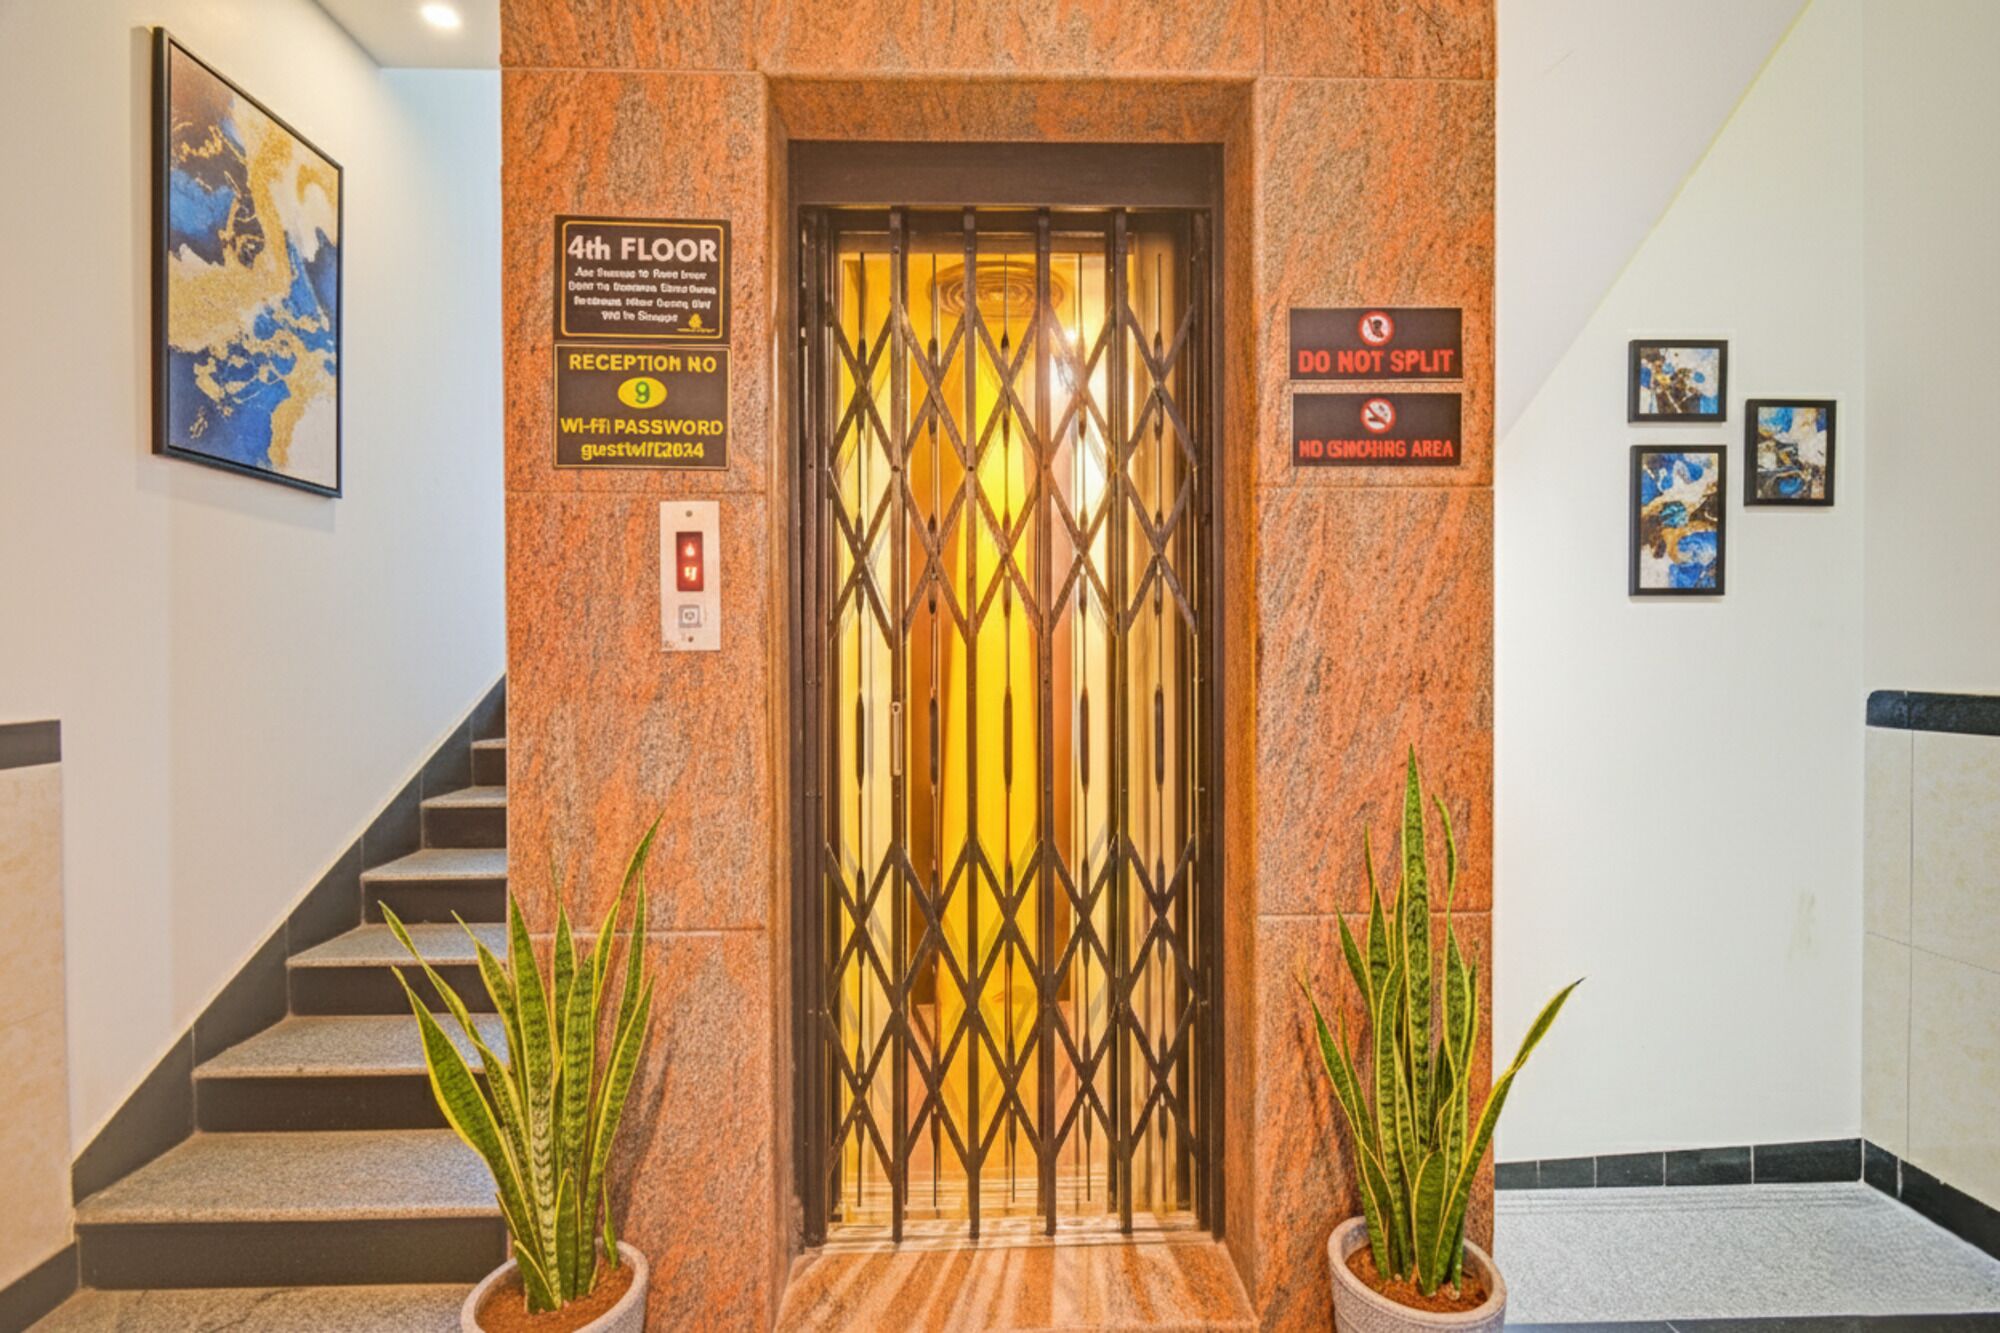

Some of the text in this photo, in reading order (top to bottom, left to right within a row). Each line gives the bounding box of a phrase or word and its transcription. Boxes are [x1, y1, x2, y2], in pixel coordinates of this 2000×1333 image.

[568, 235, 718, 263] 4th FLOOR
[569, 354, 717, 373] RECEPTION NO
[1298, 349, 1454, 374] DO NOT SPLIT
[634, 381, 651, 404] 9
[615, 418, 724, 436] PASSWORD
[1299, 439, 1323, 458] NO
[1411, 439, 1454, 458] AREA
